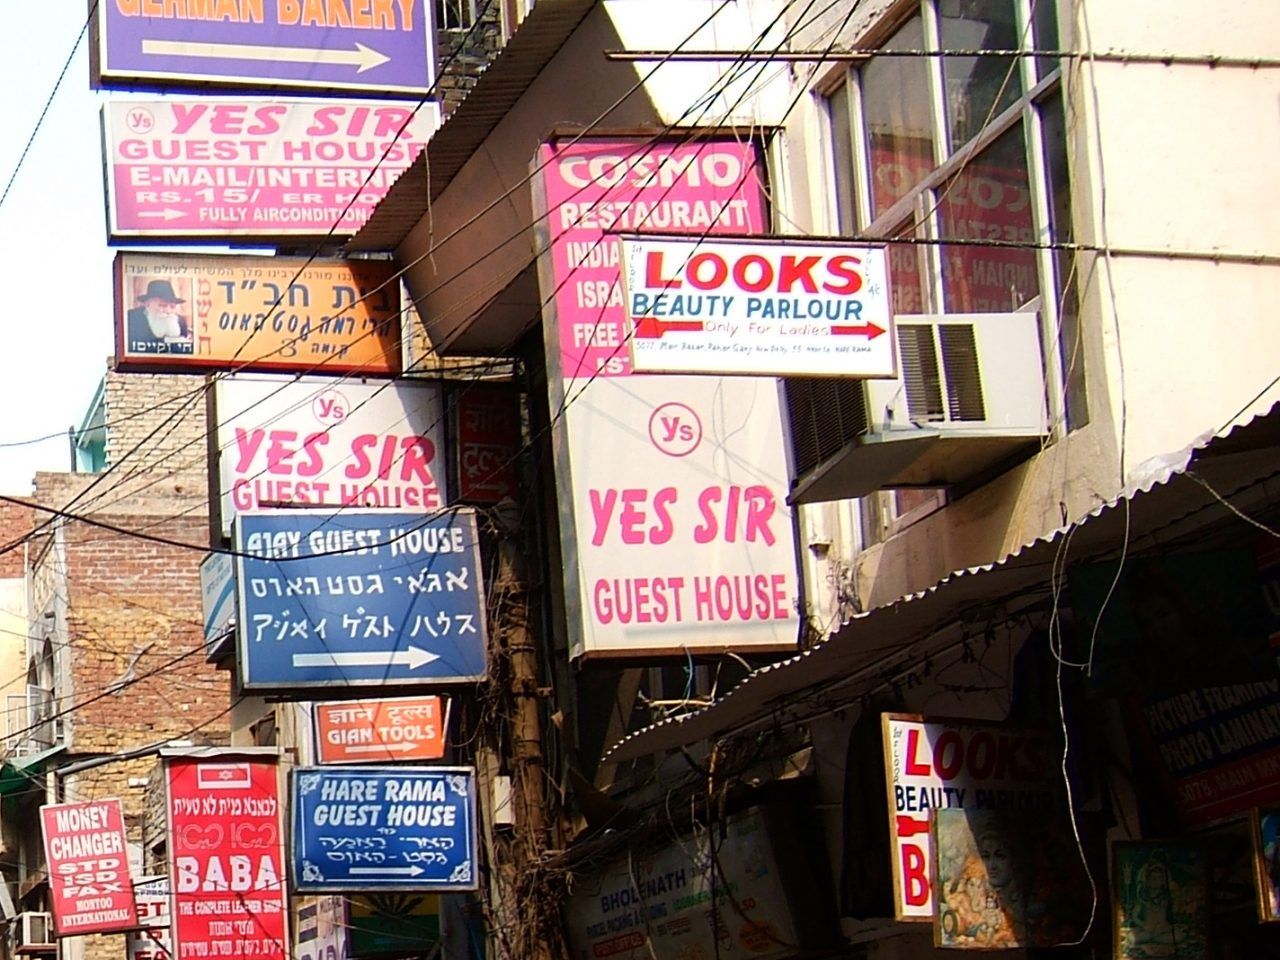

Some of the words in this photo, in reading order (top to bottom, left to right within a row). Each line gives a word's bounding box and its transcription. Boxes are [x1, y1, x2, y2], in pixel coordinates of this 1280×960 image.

[171, 103, 287, 136] YES
[306, 106, 416, 140] SIR
[119, 139, 267, 161] GUEST
[131, 166, 404, 188] E-MAIL/INTERNE
[558, 153, 744, 188] COSMO
[283, 193, 323, 203] ER
[335, 193, 382, 203] HO
[199, 207, 247, 222] FULLY
[253, 207, 370, 222] AIRCONDITION
[560, 200, 748, 228] RESTAURANT
[567, 241, 621, 268] INDIA
[645, 251, 863, 295] LOOKS
[332, 284, 392, 312] בית
[577, 281, 624, 308] ISRA
[632, 293, 734, 317] BEAUTY
[746, 297, 863, 321] PARLOUR
[574, 323, 618, 348] FREE
[705, 320, 739, 336] Only
[749, 321, 772, 335] For
[779, 322, 829, 336] Ladies
[234, 427, 329, 477] YES
[345, 434, 436, 486] SIR
[232, 479, 329, 511] GUEST
[340, 484, 440, 510] HOUSE
[588, 486, 677, 547] YES
[694, 485, 777, 547] SIR
[248, 529, 301, 560] AJAY
[309, 529, 381, 557] GUEST
[390, 527, 465, 558] HOUSE
[328, 574, 384, 596] גסט
[593, 577, 685, 625] GUEST
[696, 573, 789, 621] HOUSE
[328, 728, 373, 744] GIAN
[378, 725, 435, 741] TOOLS
[322, 780, 378, 803] HARE
[385, 780, 445, 803] RAMA
[895, 785, 966, 811] BEAUTY
[56, 805, 110, 833] MONEY
[314, 805, 381, 826] GUEST
[387, 805, 456, 826] HOUSE
[51, 831, 123, 861] CHANGER
[58, 859, 120, 875] STD
[63, 872, 117, 885] ISD
[176, 855, 280, 893] BABA
[63, 883, 123, 898] FAX
[76, 898, 113, 912] MONTOO
[136, 901, 166, 917] ST
[179, 901, 193, 915] THE
[195, 900, 230, 915] COMPLETE
[62, 910, 130, 927] INTERNATIONAL
